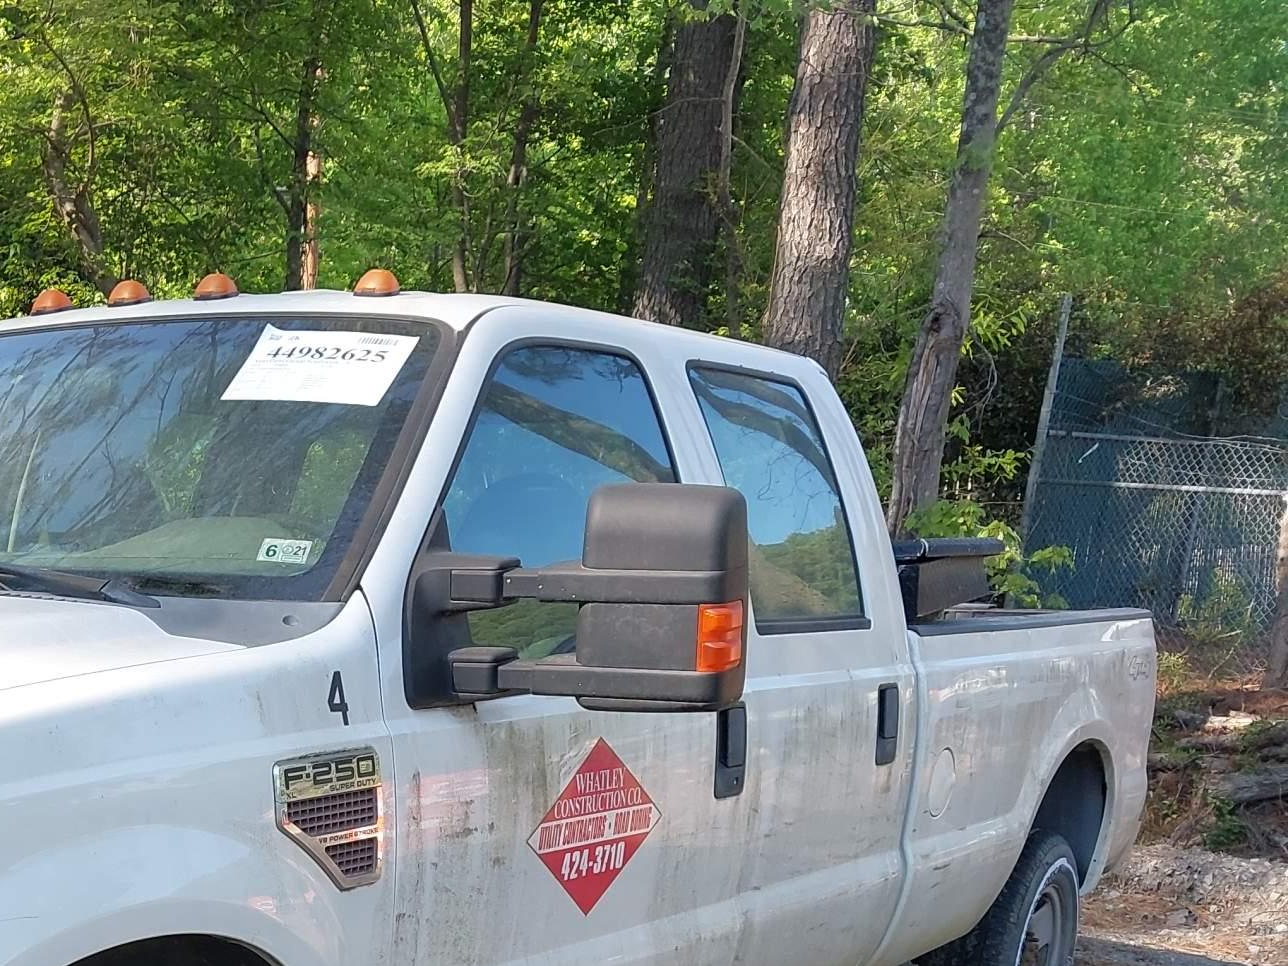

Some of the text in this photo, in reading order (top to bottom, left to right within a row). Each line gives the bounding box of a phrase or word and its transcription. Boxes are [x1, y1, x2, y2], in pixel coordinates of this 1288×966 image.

[267, 345, 390, 363] 44982625
[265, 544, 278, 558] 6
[327, 670, 349, 726] 4
[284, 755, 376, 790] F-250
[329, 779, 377, 792] SUPER DUTY
[576, 767, 626, 795] WHATLEY
[285, 791, 297, 800] XL
[554, 787, 642, 819] CONSTRUCTION CO.
[538, 823, 563, 851] UTILITY
[561, 841, 626, 881] 424-3710
